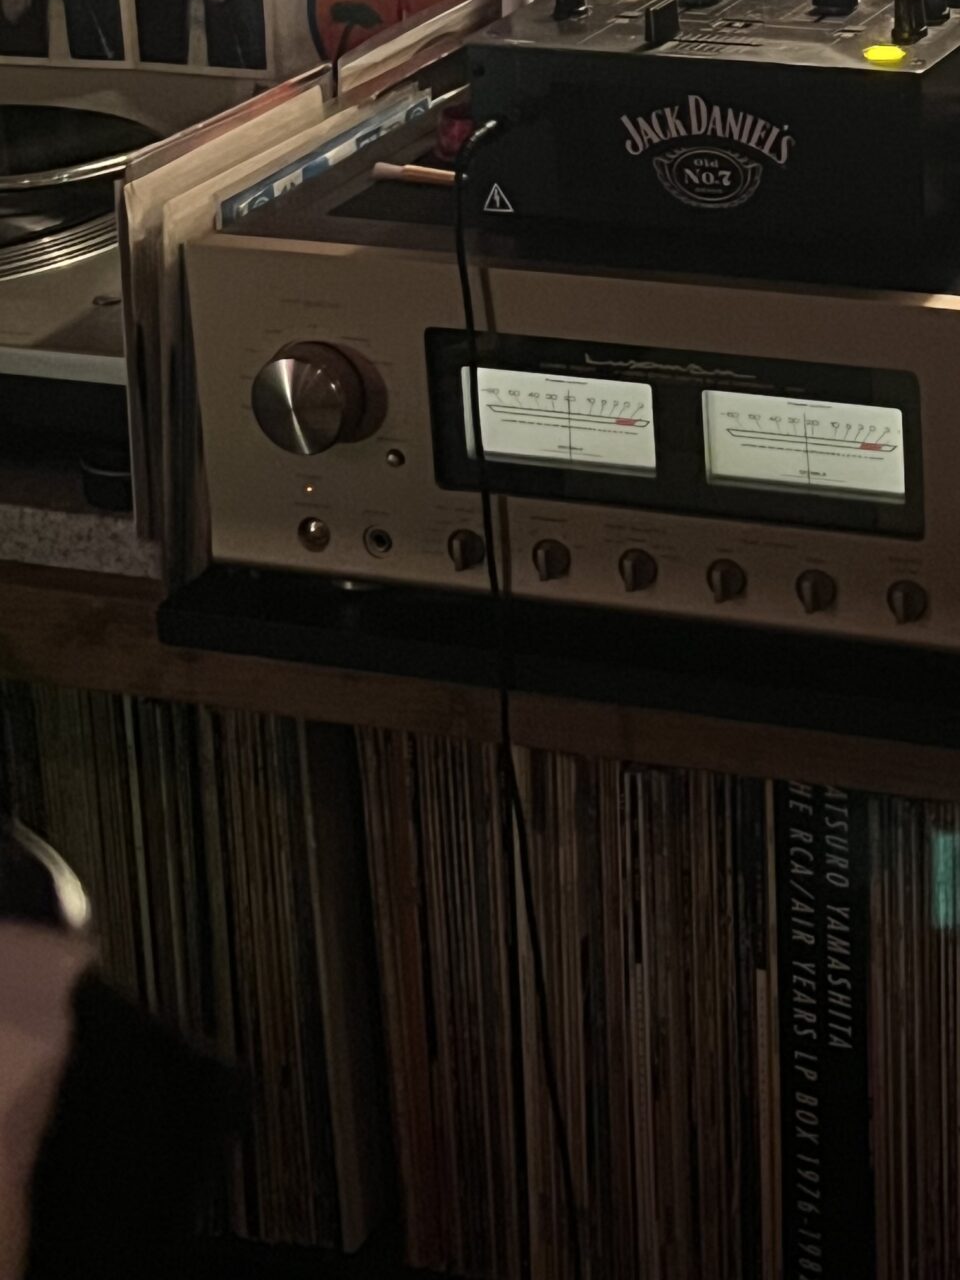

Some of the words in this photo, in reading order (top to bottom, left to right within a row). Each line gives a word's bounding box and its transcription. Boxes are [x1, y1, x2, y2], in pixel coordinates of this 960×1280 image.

[620, 105, 686, 156] JACK
[688, 94, 796, 165] DANIEL'S
[789, 827, 815, 946] RCA/AIR
[792, 960, 817, 1040] YEARS
[826, 904, 852, 1049] YAMASHITA
[794, 1050, 818, 1081] LP
[795, 1091, 819, 1145] BOX
